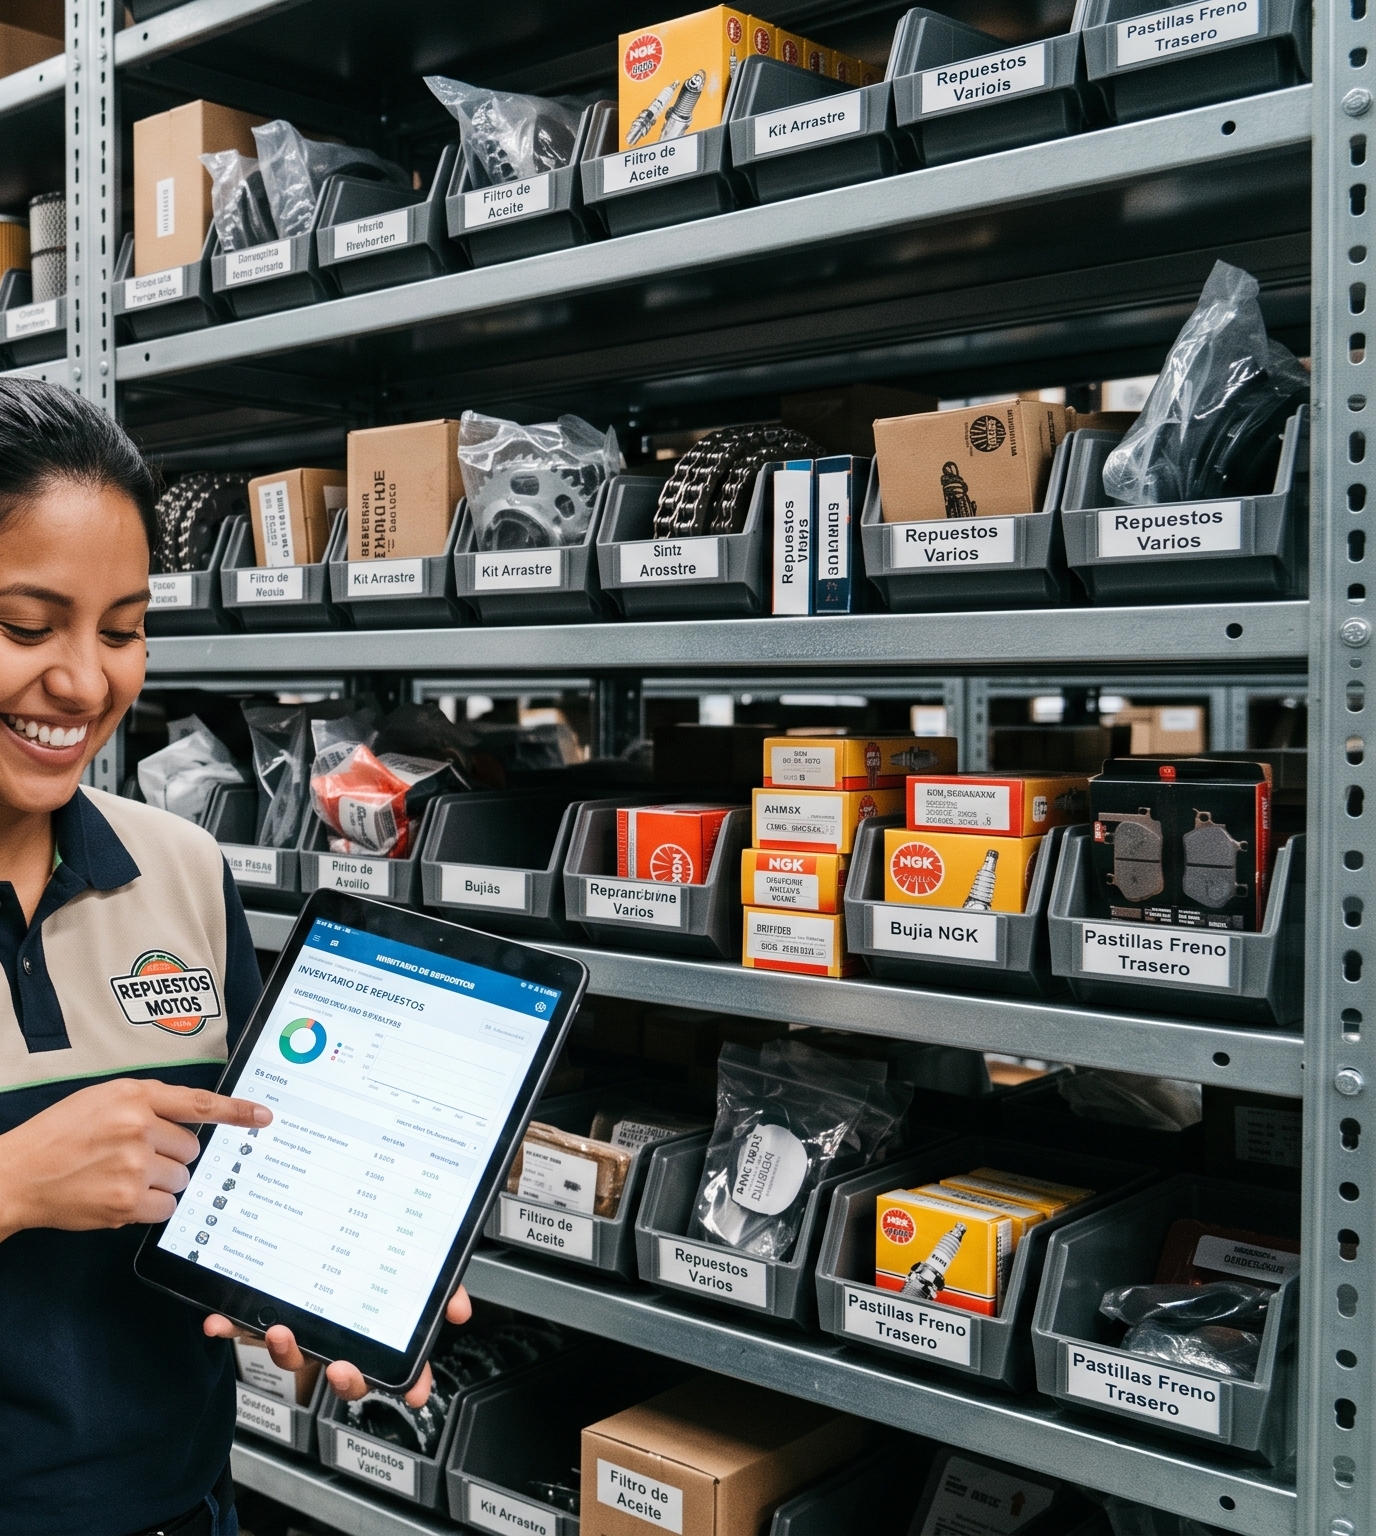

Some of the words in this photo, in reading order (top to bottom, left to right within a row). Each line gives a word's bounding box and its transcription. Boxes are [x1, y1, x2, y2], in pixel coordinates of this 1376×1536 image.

[1127, 13, 1194, 39] Pastillas
[1200, 1, 1247, 21] Freno
[1155, 29, 1218, 51] Trasero
[937, 54, 1027, 86] Repuestos
[953, 78, 1011, 102] Variois
[768, 123, 787, 138] Kit
[790, 110, 846, 133] Arrastre
[660, 145, 676, 158] de
[629, 165, 669, 183] Aceite
[516, 183, 531, 196] de
[487, 202, 524, 219] Aceite
[1115, 510, 1223, 532] Repuestos
[782, 500, 796, 584] Repuestos
[905, 525, 998, 545] Repuestos
[1137, 534, 1202, 551] Varios
[653, 544, 682, 558] Sintz
[924, 548, 979, 563] Varios
[277, 572, 289, 583] de
[353, 573, 369, 585] Kit
[371, 571, 415, 584] Arrastre
[482, 566, 499, 578] Kit
[501, 563, 552, 577] Arrastre
[640, 563, 697, 577] Arosstre
[360, 862, 374, 875] de
[768, 857, 804, 872] NGK
[899, 855, 934, 870] NGK
[613, 902, 654, 918] Varios
[890, 921, 933, 940] Bujía
[938, 925, 978, 943] NGK
[1084, 929, 1163, 951] Pastillas
[1169, 937, 1227, 957] Freno
[1118, 955, 1191, 976] Trasero
[117, 975, 211, 1000] REPUESTOS
[297, 964, 355, 989] INVENTARIO
[355, 983, 370, 994] DE
[369, 987, 426, 1012] REPUESTOS
[144, 996, 202, 1017] MOTOS
[557, 1218, 573, 1232] de
[526, 1228, 565, 1248] Aceite
[675, 1247, 748, 1278] Repuestos
[688, 1269, 733, 1292] Varios
[848, 1293, 914, 1323] Pastillas
[919, 1312, 966, 1337] Freno
[875, 1321, 938, 1350] Trasero
[1073, 1352, 1152, 1386] Pastillas
[1158, 1374, 1216, 1402] Freno
[1105, 1382, 1179, 1416] Trasero
[347, 1438, 405, 1471] Repuestos
[357, 1458, 392, 1482] Varios
[610, 1469, 647, 1495] Filtro
[651, 1486, 669, 1504] de
[480, 1499, 496, 1515] Kit
[616, 1492, 662, 1521] Aceite
